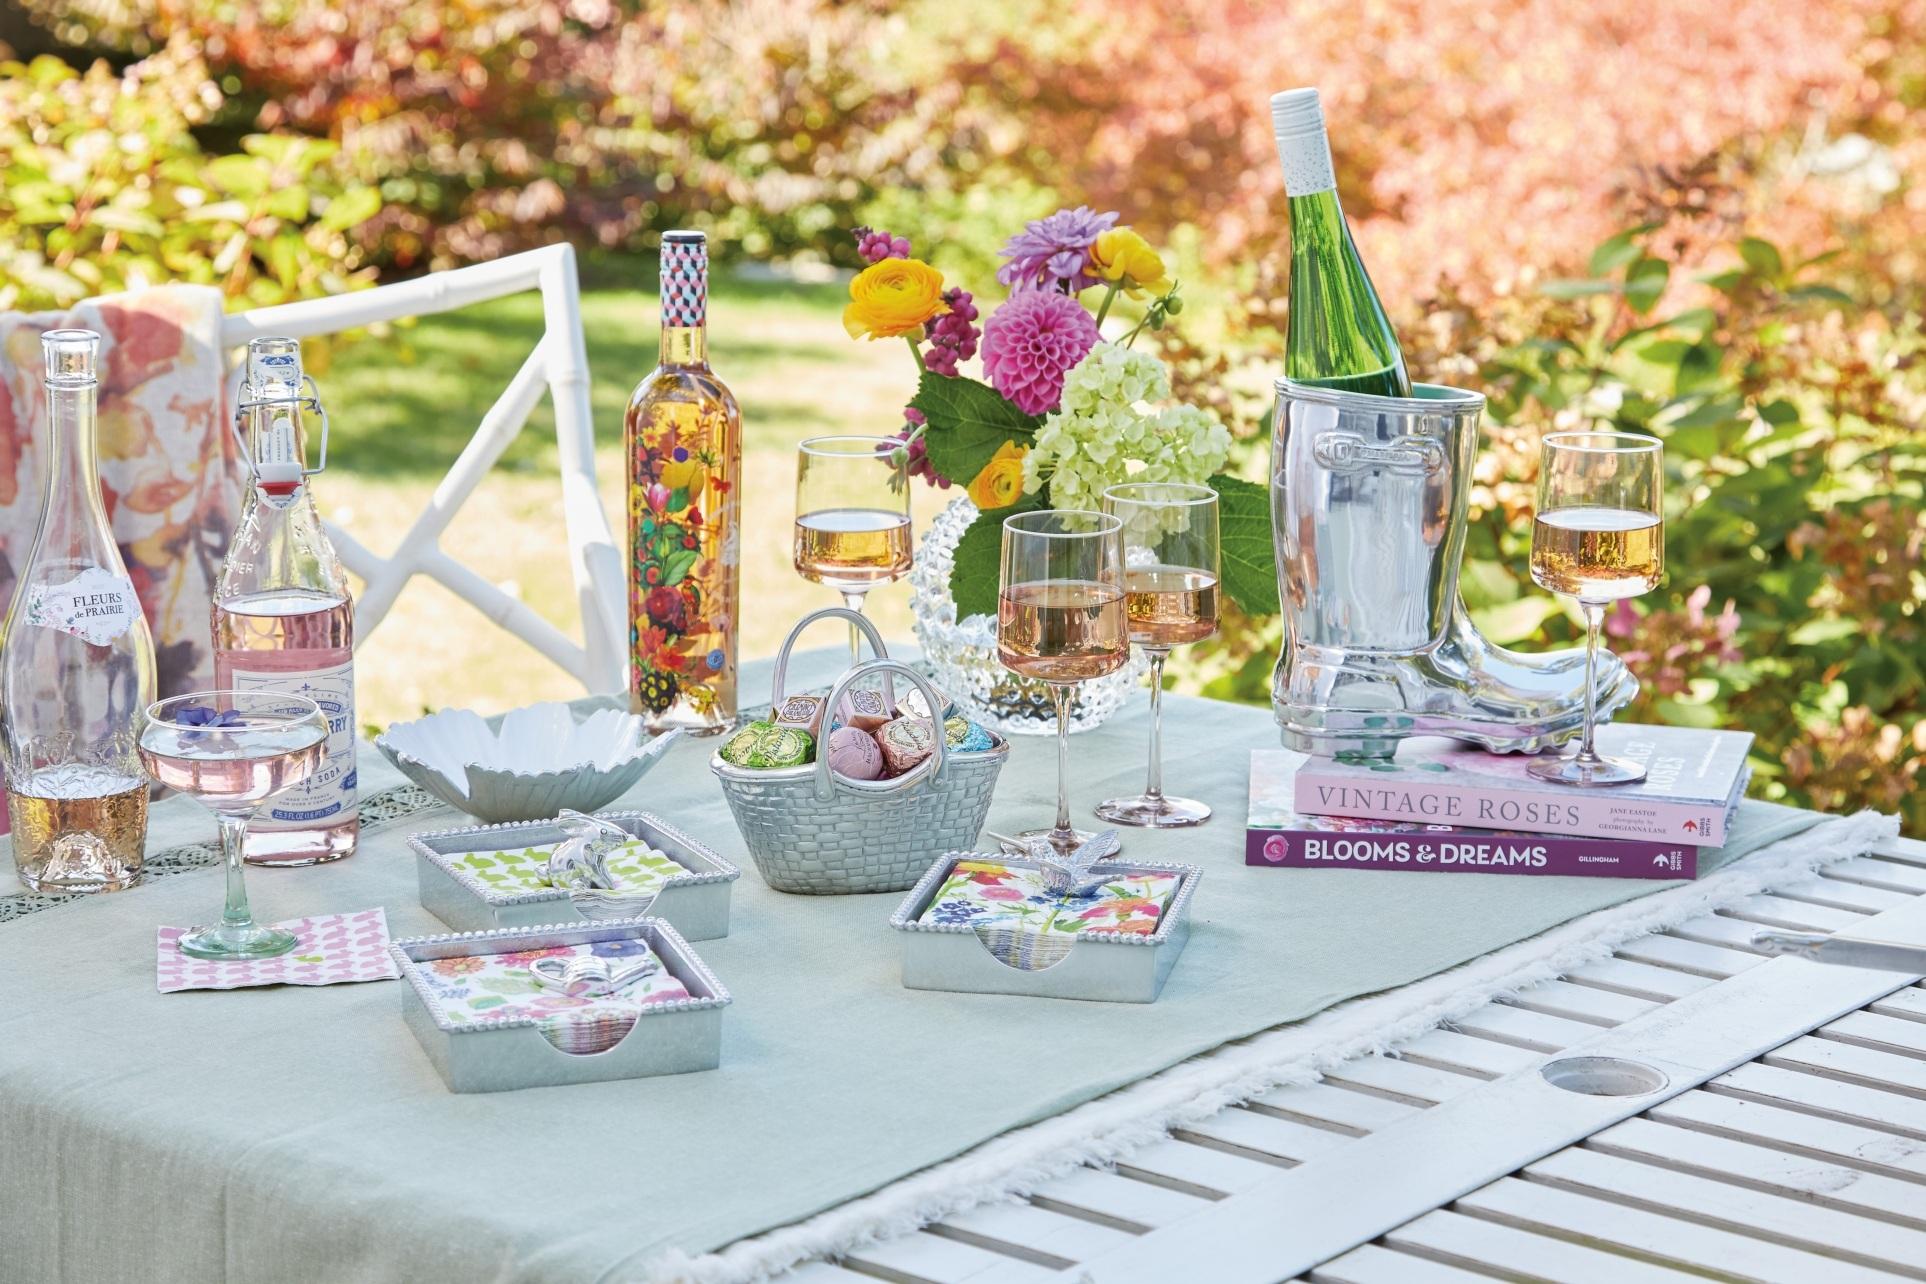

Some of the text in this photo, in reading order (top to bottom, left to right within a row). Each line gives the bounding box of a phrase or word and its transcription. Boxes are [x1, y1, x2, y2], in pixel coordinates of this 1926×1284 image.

[73, 592, 122, 607] FLEURS
[75, 605, 124, 619] de PRAIRIE
[319, 767, 340, 782] SODA
[1317, 785, 1581, 826] VINTAGE ROSES
[1609, 807, 1627, 815] JANE
[1598, 823, 1647, 833] GEORGIANNA
[1304, 839, 1548, 867] BLOOMS & DREAMS
[1578, 855, 1620, 863] GILLINGHAM
